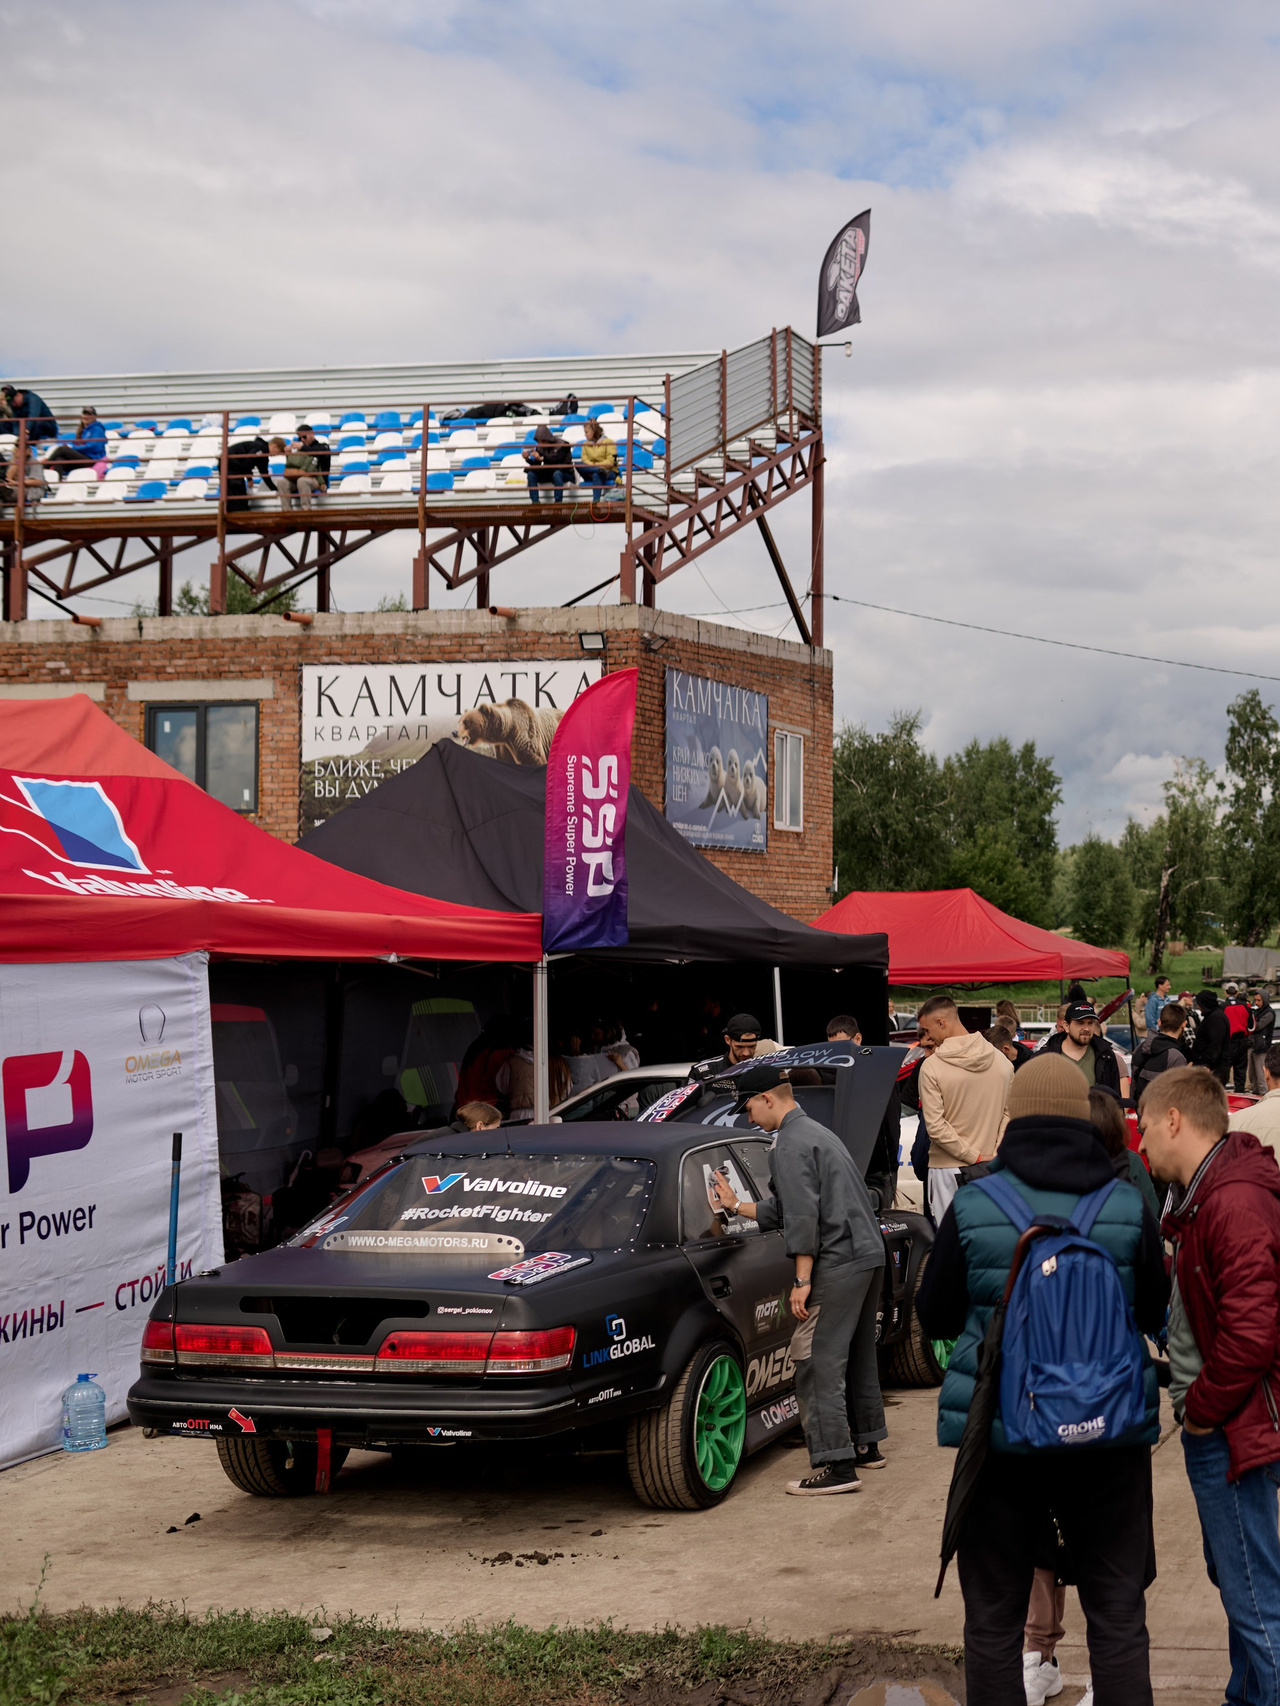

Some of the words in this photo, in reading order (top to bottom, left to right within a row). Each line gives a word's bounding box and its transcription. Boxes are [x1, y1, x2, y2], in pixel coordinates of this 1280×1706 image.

[673, 670, 762, 728] КАМЧАТКА
[673, 712, 697, 725] КВАРТАЛ
[314, 725, 428, 742] КВАРТАЛ
[672, 746, 690, 763] КРАЙ
[314, 759, 385, 779] БЛИЖЕ,
[390, 759, 417, 774] ЧЕ
[672, 765, 700, 785] НИЗКИХ
[314, 780, 339, 798] ВЫ
[566, 755, 577, 813] Supreme
[672, 785, 687, 802] ЦЕН
[565, 816, 578, 854] Super
[582, 755, 618, 897] SSP
[566, 857, 577, 896] Power
[125, 1049, 182, 1073] OMEGA
[125, 1071, 154, 1084] MOTOR
[156, 1066, 182, 1079] SPORT
[463, 1177, 568, 1199] Valvoline
[19, 1203, 96, 1245] Power
[347, 1235, 488, 1249] WWW.O-MEGAMOTORS.RU
[488, 1251, 571, 1281] SSP
[115, 1259, 193, 1311] СТОЙИ
[441, 1429, 472, 1437] Valvoline
[1058, 1416, 1105, 1437] GROHE
